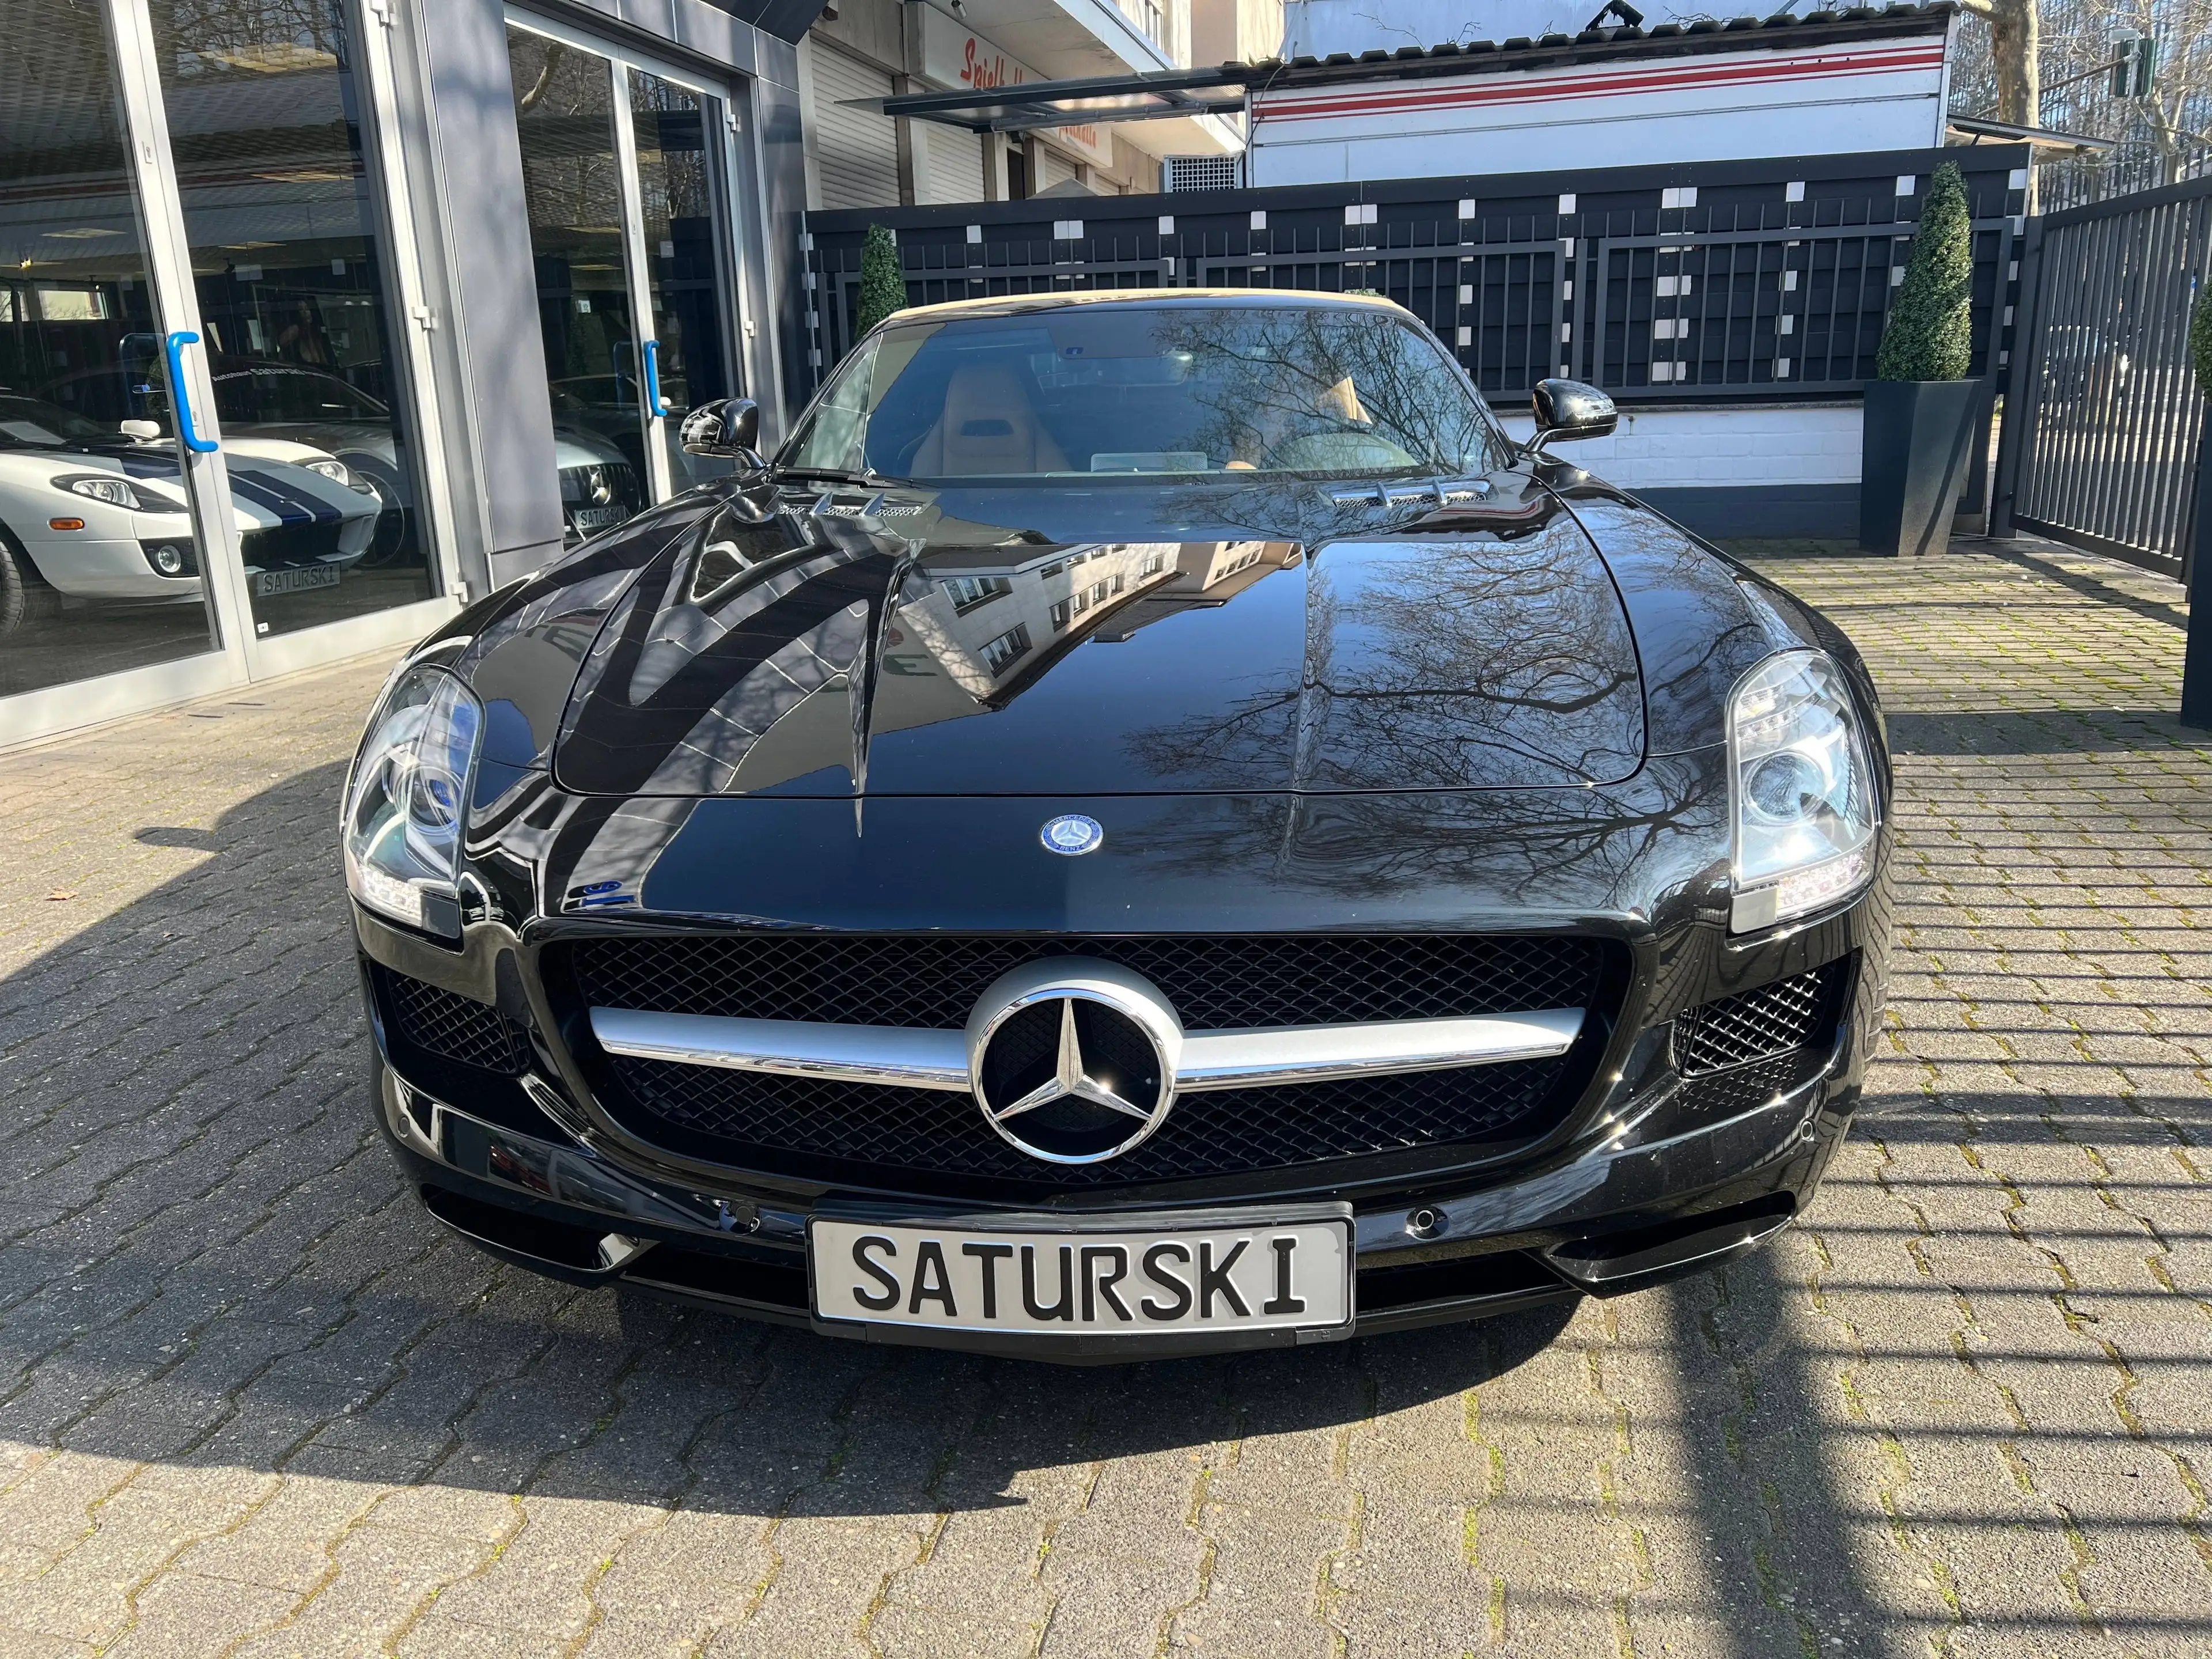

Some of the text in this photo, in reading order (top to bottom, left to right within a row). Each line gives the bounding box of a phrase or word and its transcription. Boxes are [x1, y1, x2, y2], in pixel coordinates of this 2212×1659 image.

[263, 566, 334, 593] SATURSKI
[1053, 815, 1092, 825] MERCEDES
[852, 1236, 1307, 1321] SATURSKI
